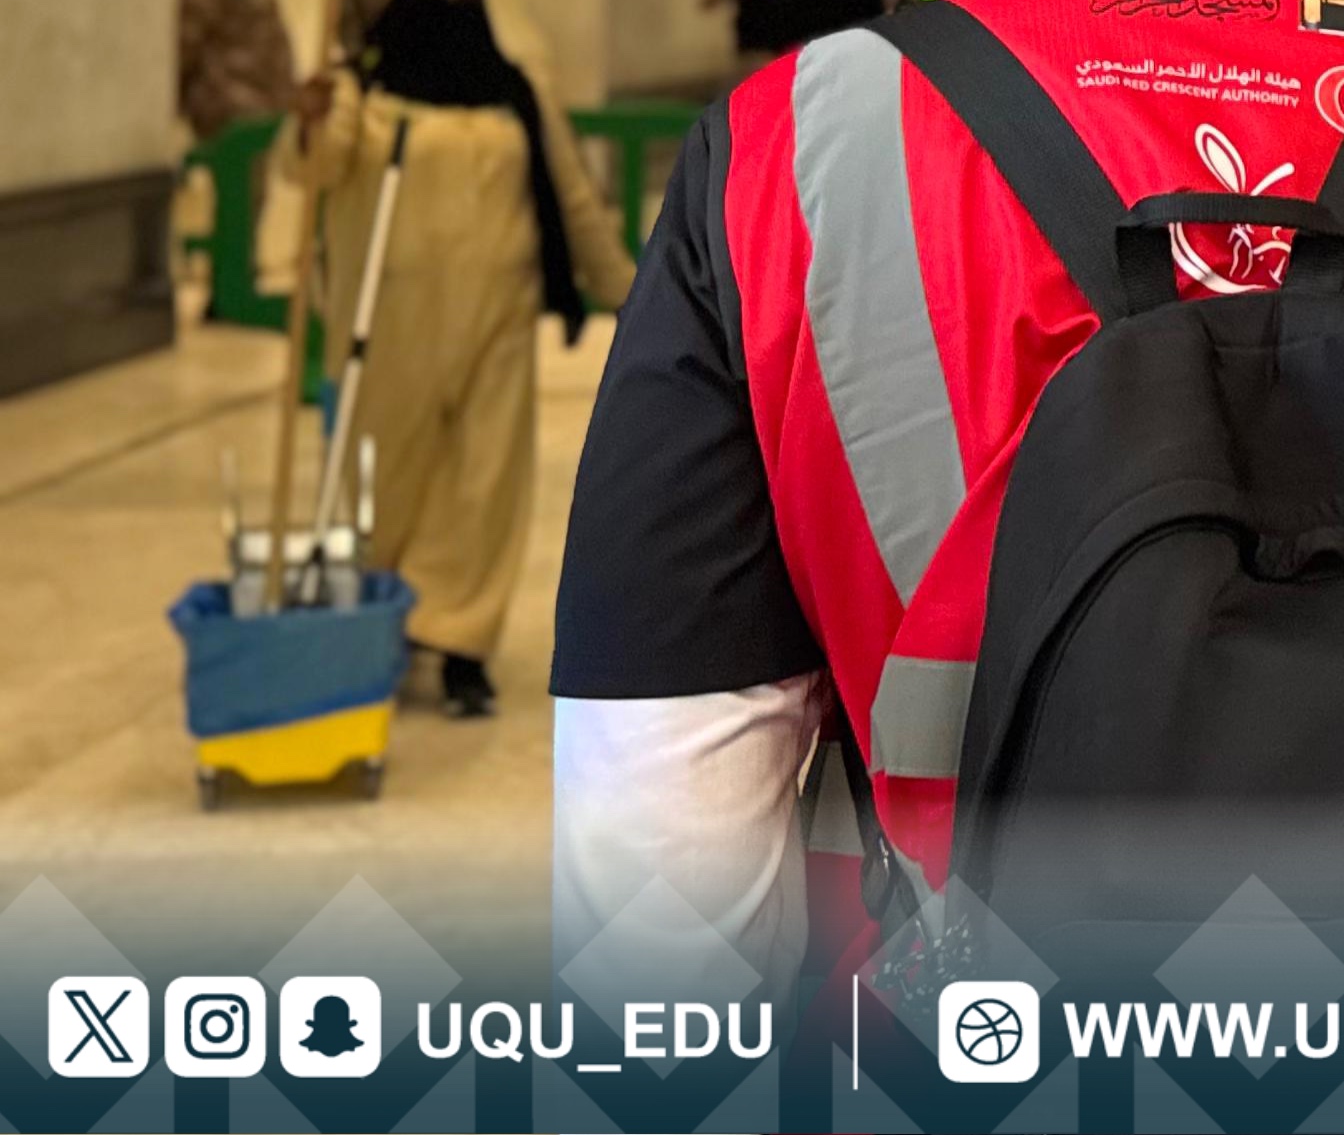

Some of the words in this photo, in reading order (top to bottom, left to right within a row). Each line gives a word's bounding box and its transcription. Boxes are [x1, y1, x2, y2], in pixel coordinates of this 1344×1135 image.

[1075, 58, 1155, 76] السعودي
[1156, 62, 1206, 80] الأحمر
[1208, 63, 1261, 85] الهلال
[1076, 74, 1121, 89] SAUDI
[1123, 77, 1149, 92] RED
[1152, 79, 1219, 100] CRESCENT
[1220, 88, 1300, 109] AUTHORITY
